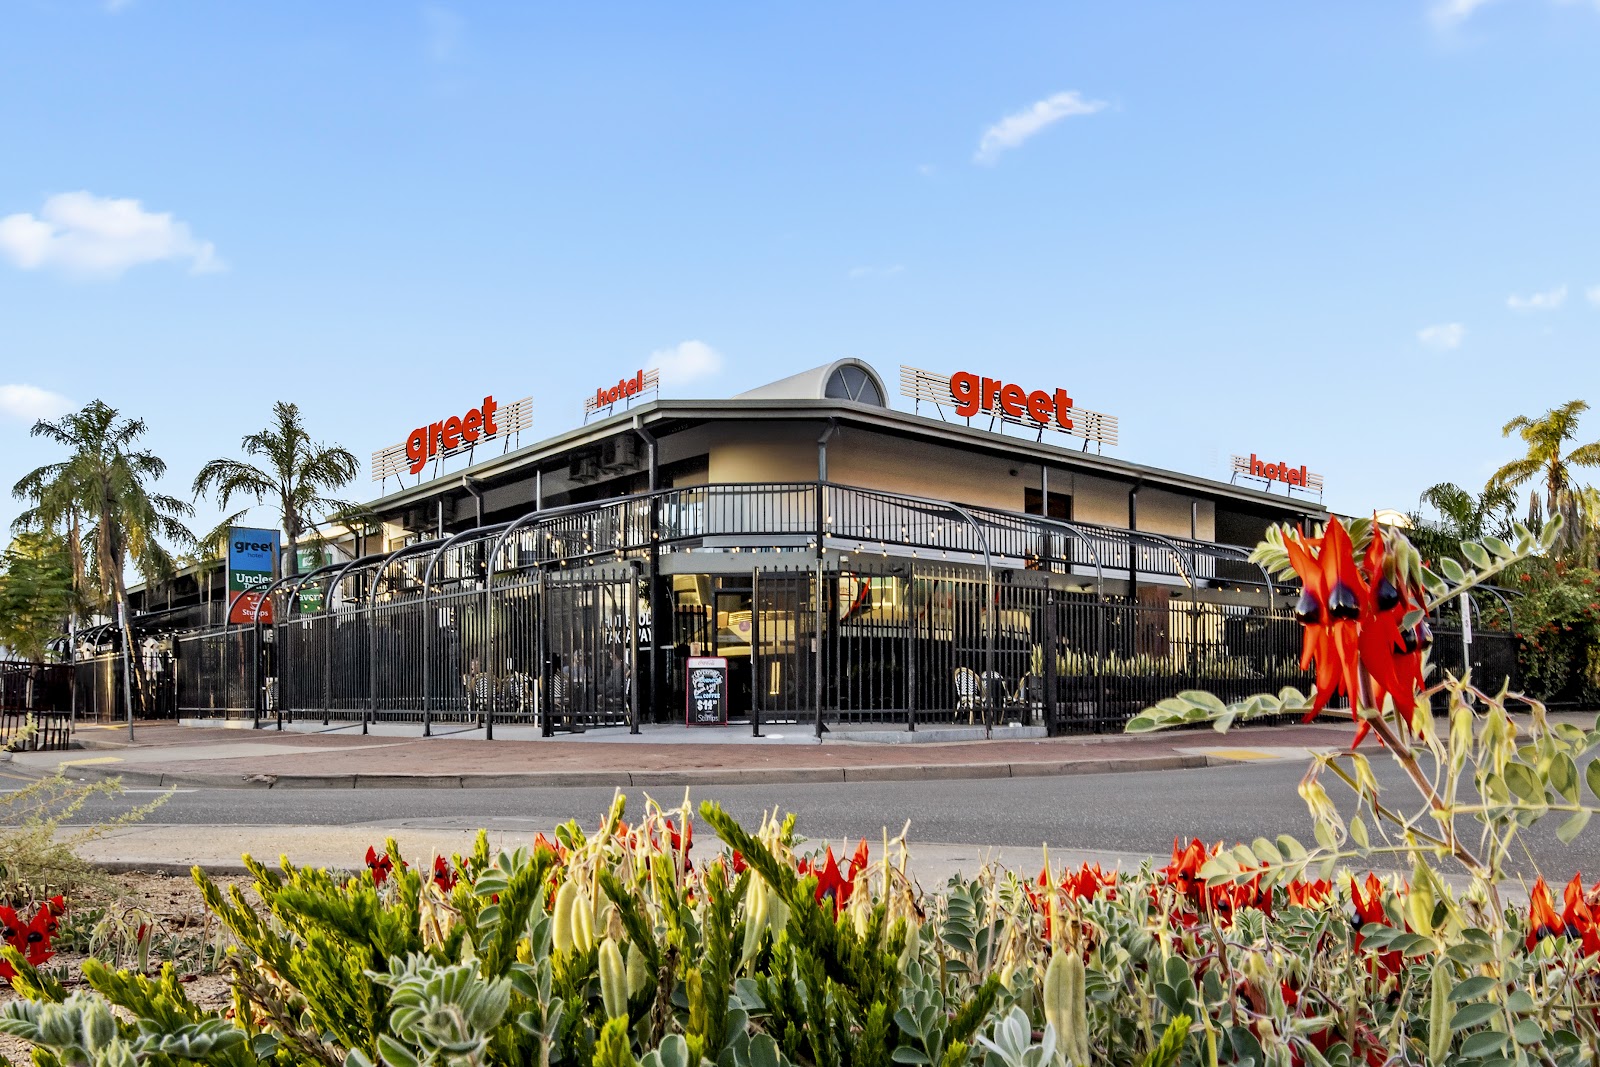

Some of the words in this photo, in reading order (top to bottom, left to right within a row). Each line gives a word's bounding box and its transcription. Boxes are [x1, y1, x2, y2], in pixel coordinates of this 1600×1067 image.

[597, 369, 643, 408] hotel
[950, 371, 1074, 429] greet
[406, 395, 498, 474] greet
[1249, 454, 1307, 487] hotel
[234, 541, 273, 553] greet
[235, 573, 274, 583] Uncles
[625, 613, 651, 627] FOD
